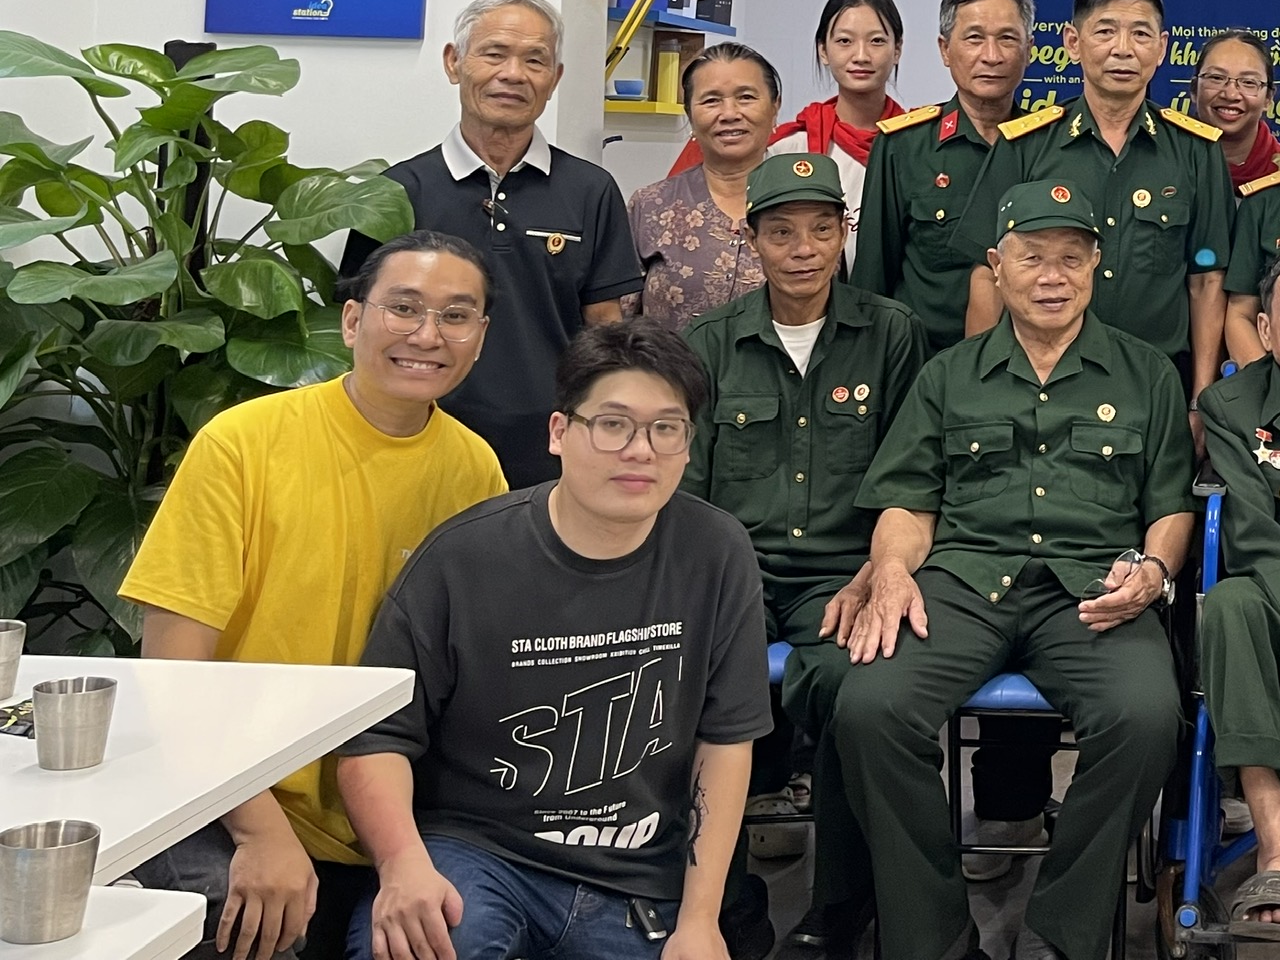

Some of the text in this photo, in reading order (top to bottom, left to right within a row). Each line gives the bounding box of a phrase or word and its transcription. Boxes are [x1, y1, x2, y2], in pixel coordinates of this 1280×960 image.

[292, 9, 323, 17] station
[1171, 26, 1195, 39] Mọi
[1197, 26, 1229, 38] thàn
[1044, 75, 1080, 84] with an
[511, 639, 533, 653] STA
[534, 637, 568, 652] CLOTH
[569, 633, 606, 649] BRAND
[537, 657, 572, 666] COLLECTION
[574, 652, 608, 662] SHOWROOM
[603, 801, 627, 814] Future
[543, 812, 618, 822] from Underground
